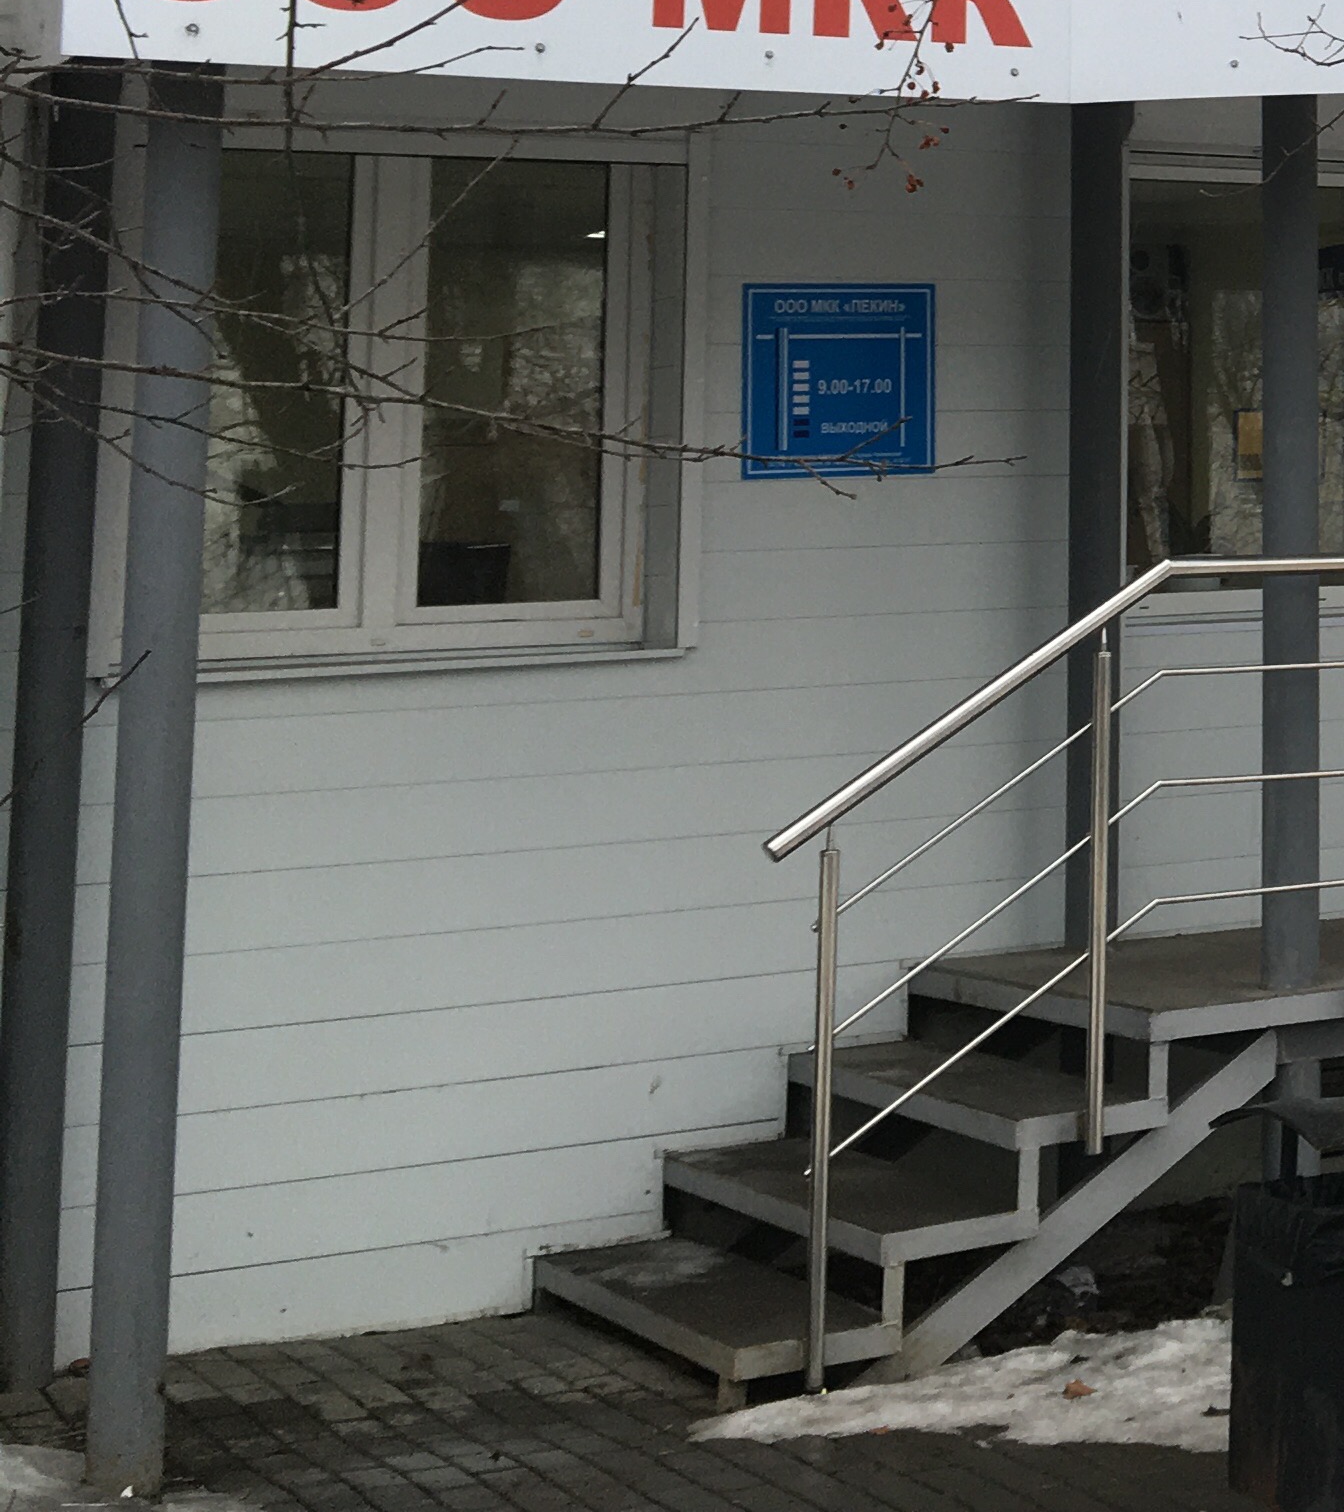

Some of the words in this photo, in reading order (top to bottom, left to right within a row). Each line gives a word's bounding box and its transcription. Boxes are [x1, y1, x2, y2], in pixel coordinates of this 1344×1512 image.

[774, 298, 808, 314] ООО
[811, 298, 840, 314] МКК
[843, 298, 906, 313] «ПЕКИН»
[817, 378, 893, 395] 9.00-17.00
[821, 419, 889, 434] ВЫХОДНОЙ
